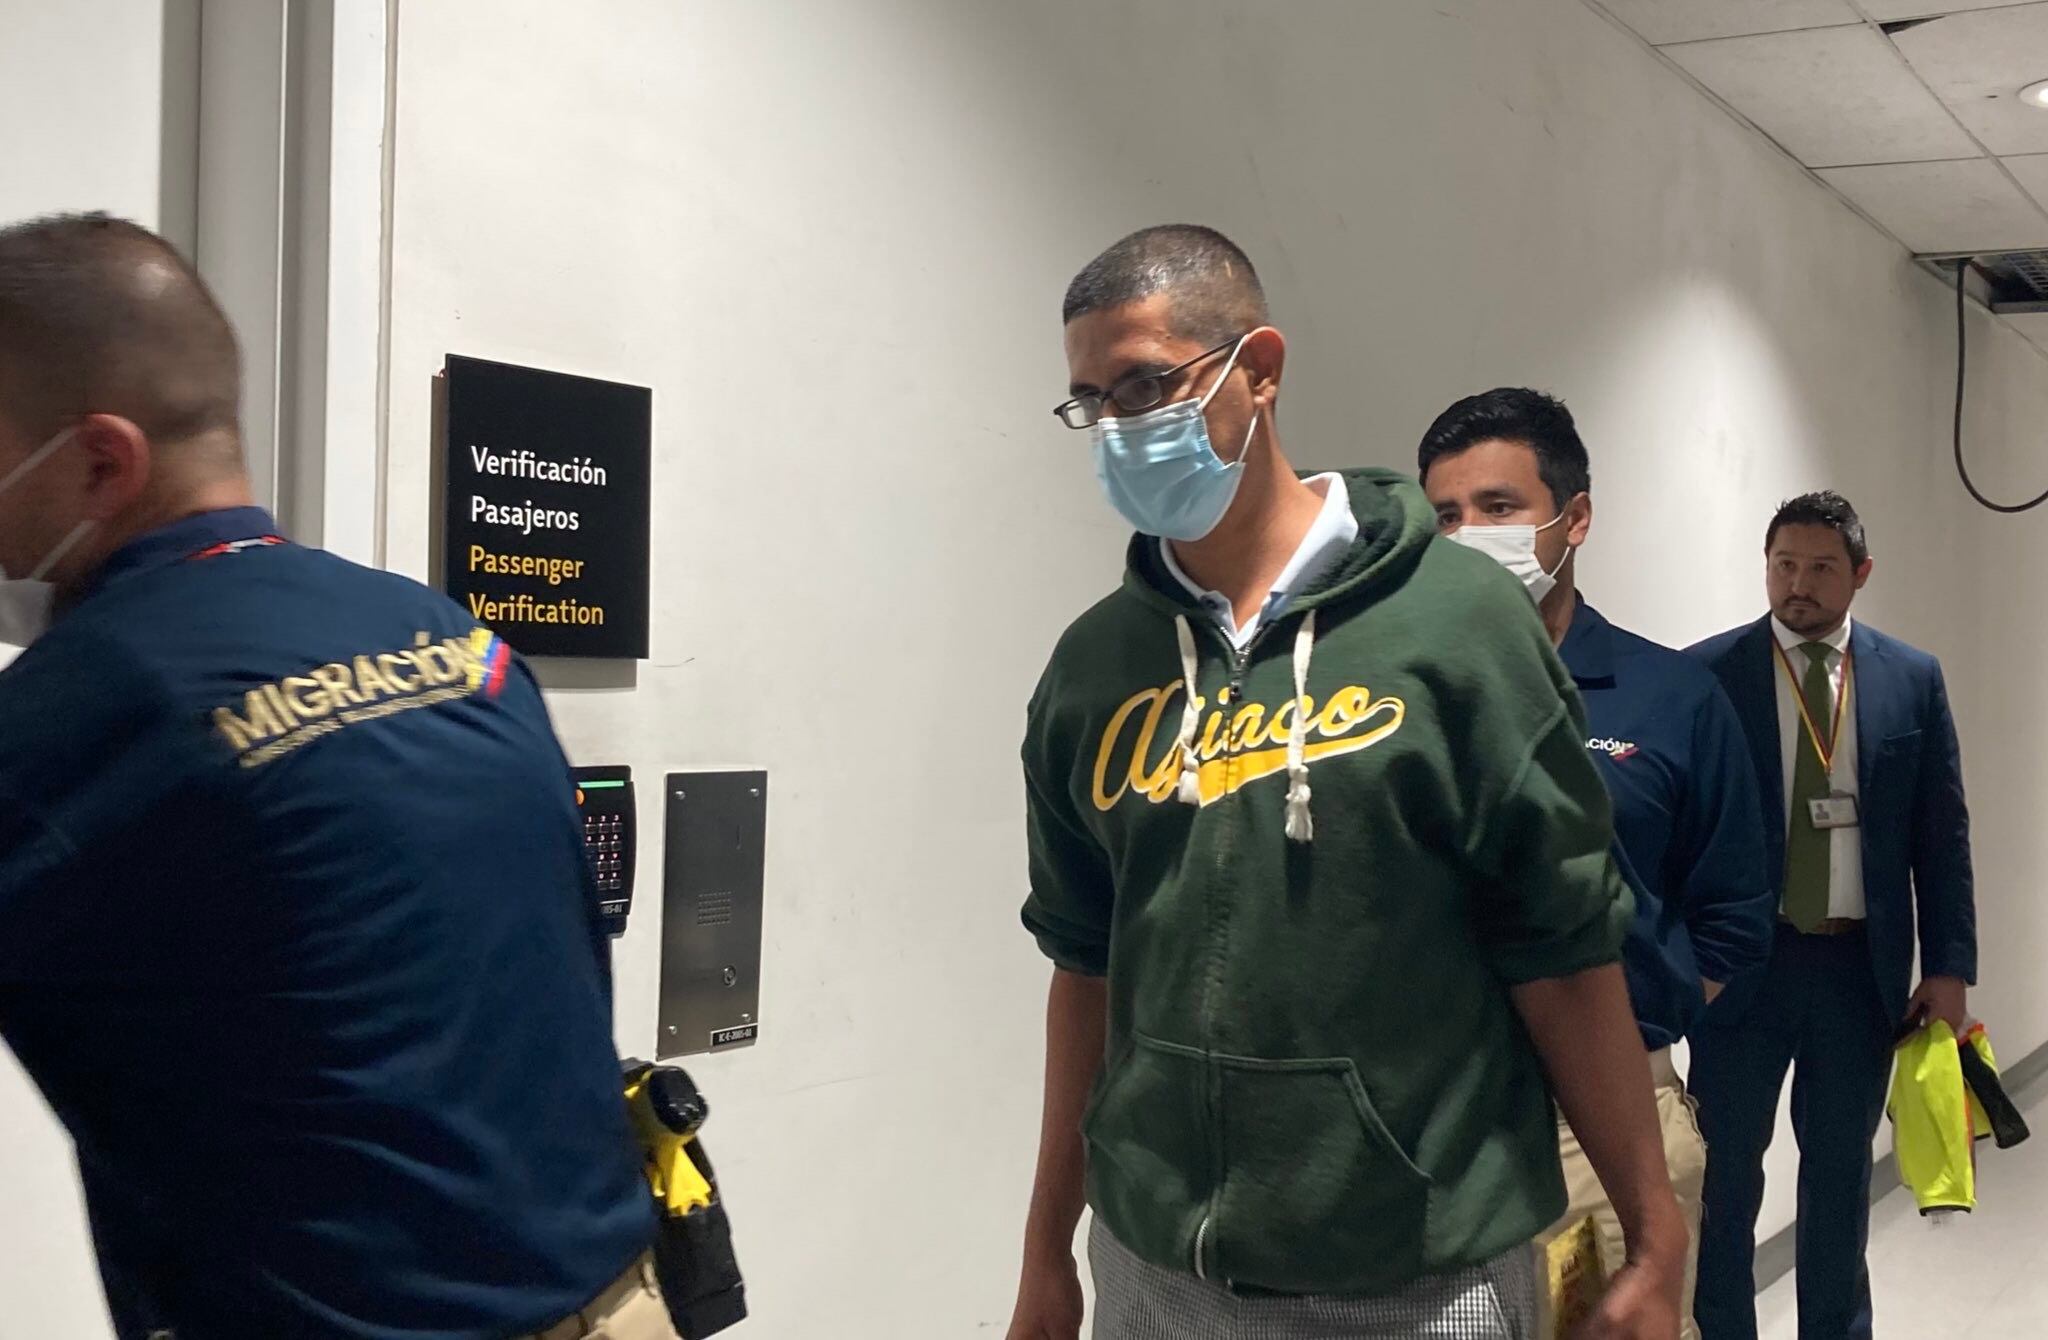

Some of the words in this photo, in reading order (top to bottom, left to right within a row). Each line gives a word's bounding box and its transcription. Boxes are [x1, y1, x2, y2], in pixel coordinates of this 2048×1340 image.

[470, 445, 607, 486] Verificación
[471, 495, 580, 535] Pasajeros
[469, 545, 584, 584] Passenger
[469, 592, 604, 625] Verification
